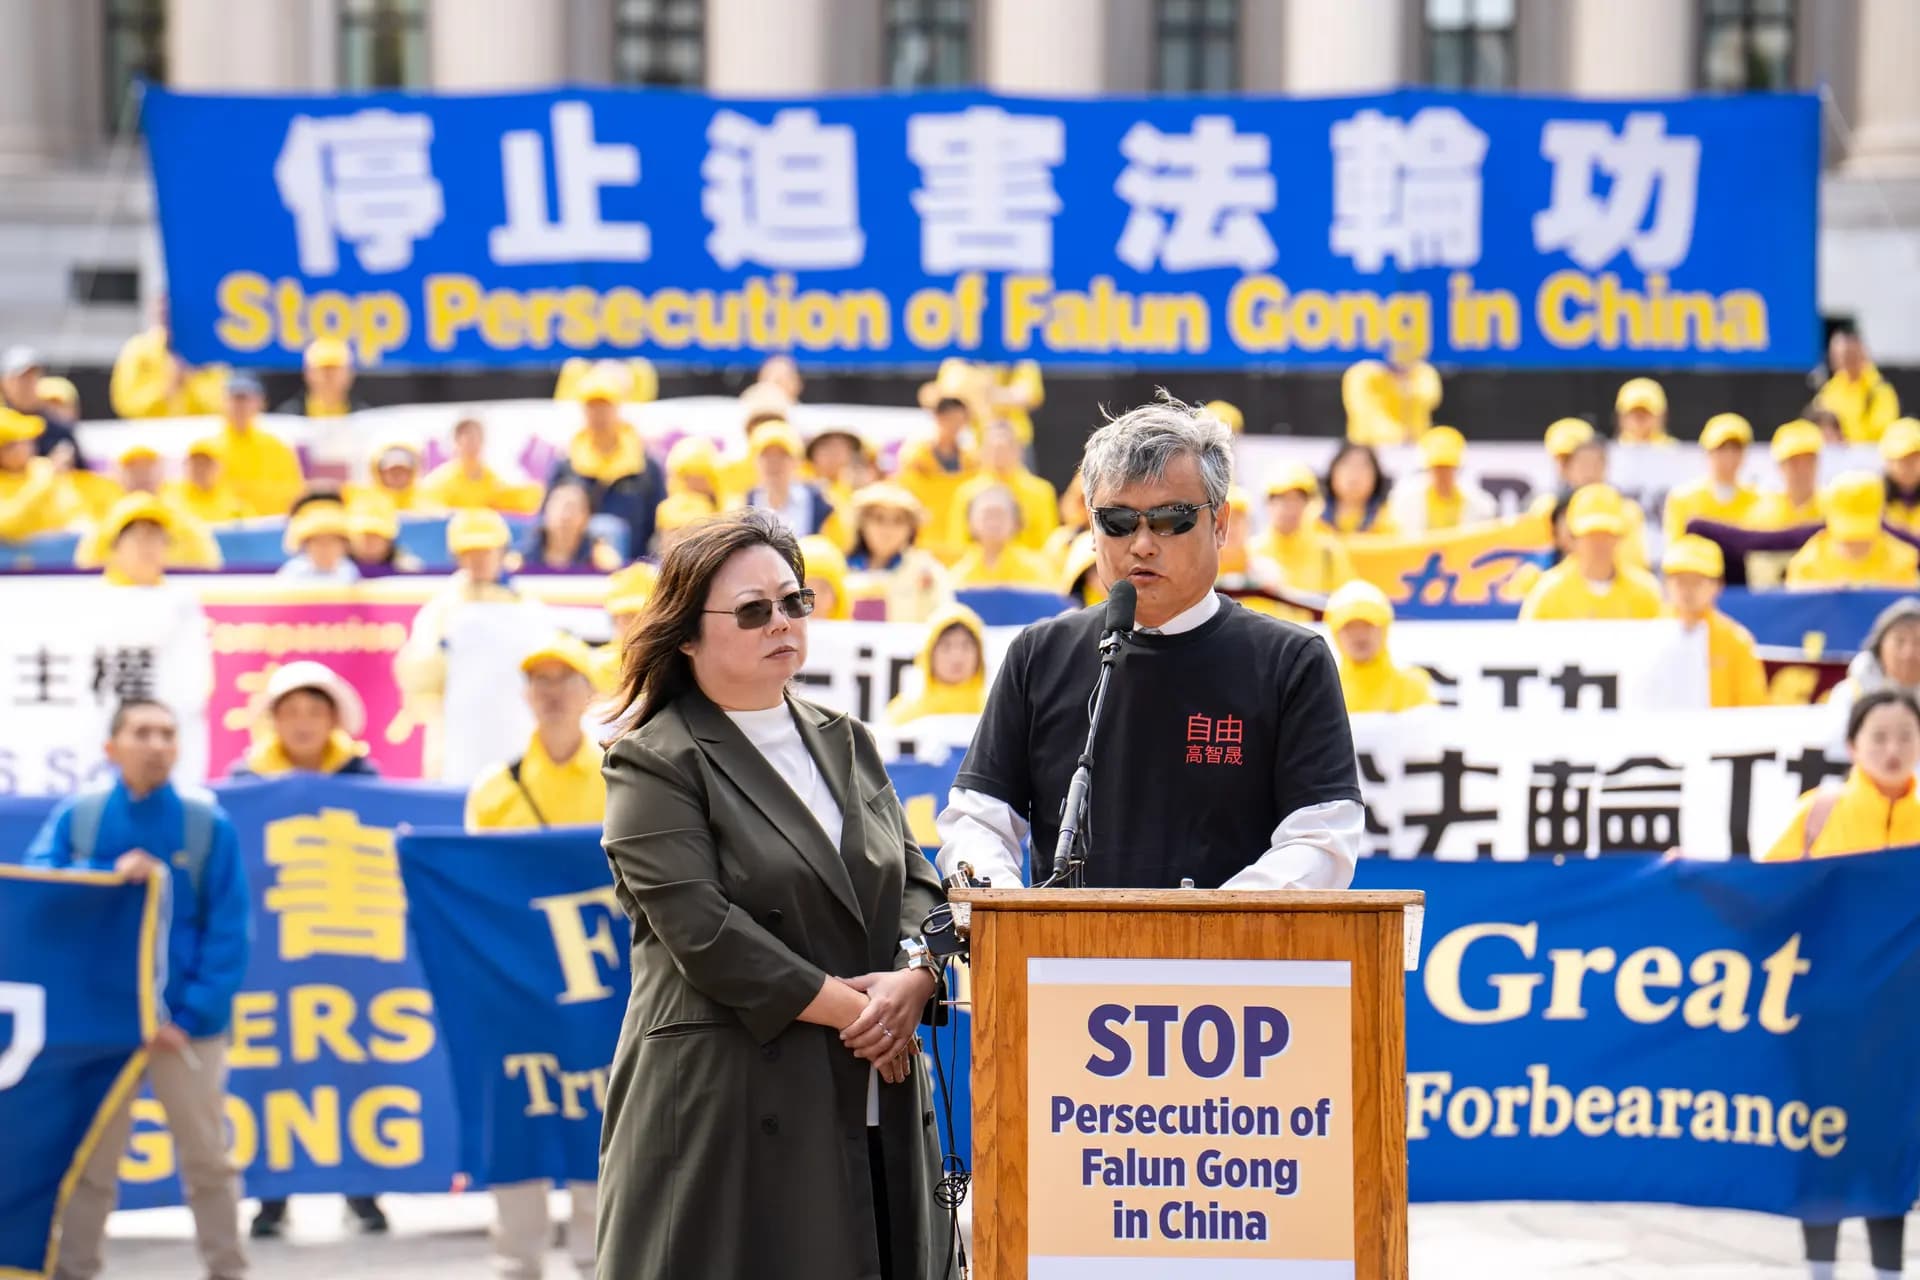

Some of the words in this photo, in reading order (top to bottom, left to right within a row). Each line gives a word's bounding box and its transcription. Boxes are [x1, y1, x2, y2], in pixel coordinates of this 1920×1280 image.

[275, 102, 1701, 274] 停止迫害法輪功
[216, 272, 408, 367] Stop
[425, 272, 890, 350] Persecution
[905, 271, 986, 350] of
[1002, 272, 1210, 352] Falun
[1227, 272, 1432, 364] Gong
[1449, 271, 1520, 350] in
[1536, 271, 1768, 352] China
[1185, 744, 1243, 766] 高智晟
[1187, 713, 1243, 744] 自由
[1423, 921, 1811, 1034] Great
[228, 983, 435, 1068] ERS
[1085, 1003, 1290, 1079] STOP
[1051, 1095, 1279, 1137] Persecution
[1290, 1096, 1330, 1137] of
[1407, 1064, 1848, 1158] Forbearance
[1081, 1147, 1186, 1188] Falun
[1195, 1149, 1299, 1196] Gong
[1112, 1200, 1148, 1239] in
[1158, 1200, 1268, 1241] China
